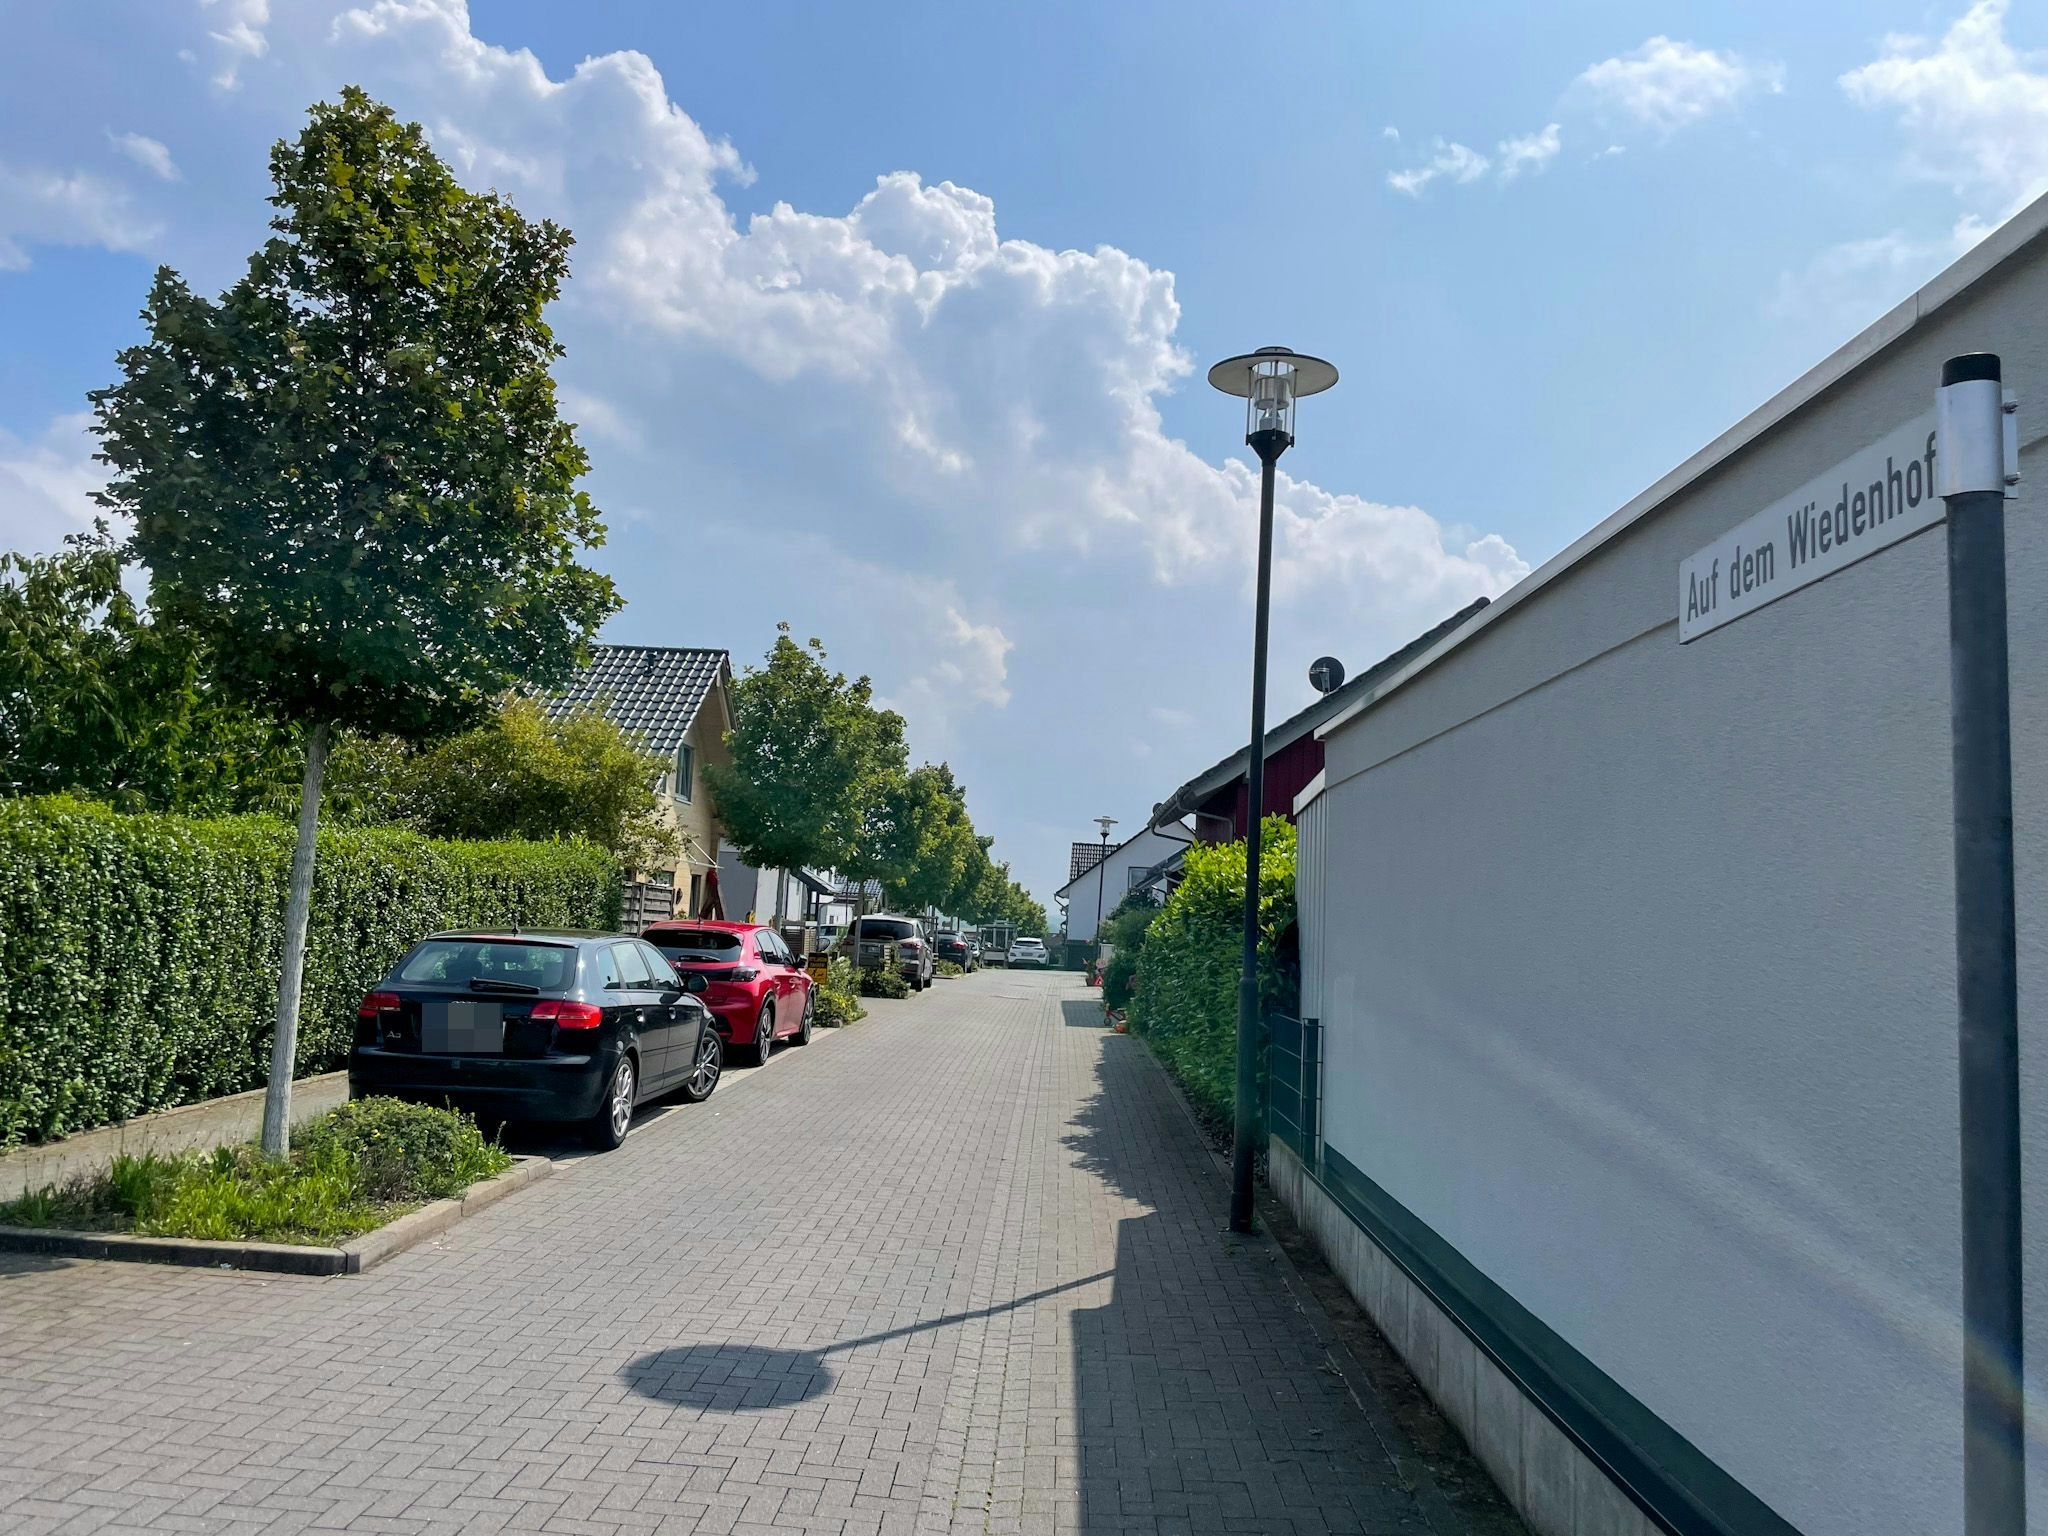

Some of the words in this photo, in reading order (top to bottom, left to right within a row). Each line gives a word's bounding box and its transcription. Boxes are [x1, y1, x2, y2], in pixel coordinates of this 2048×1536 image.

[1687, 558, 1719, 622] Auf
[1730, 541, 1775, 600] dem
[1787, 430, 1937, 569] Wiedenhof
